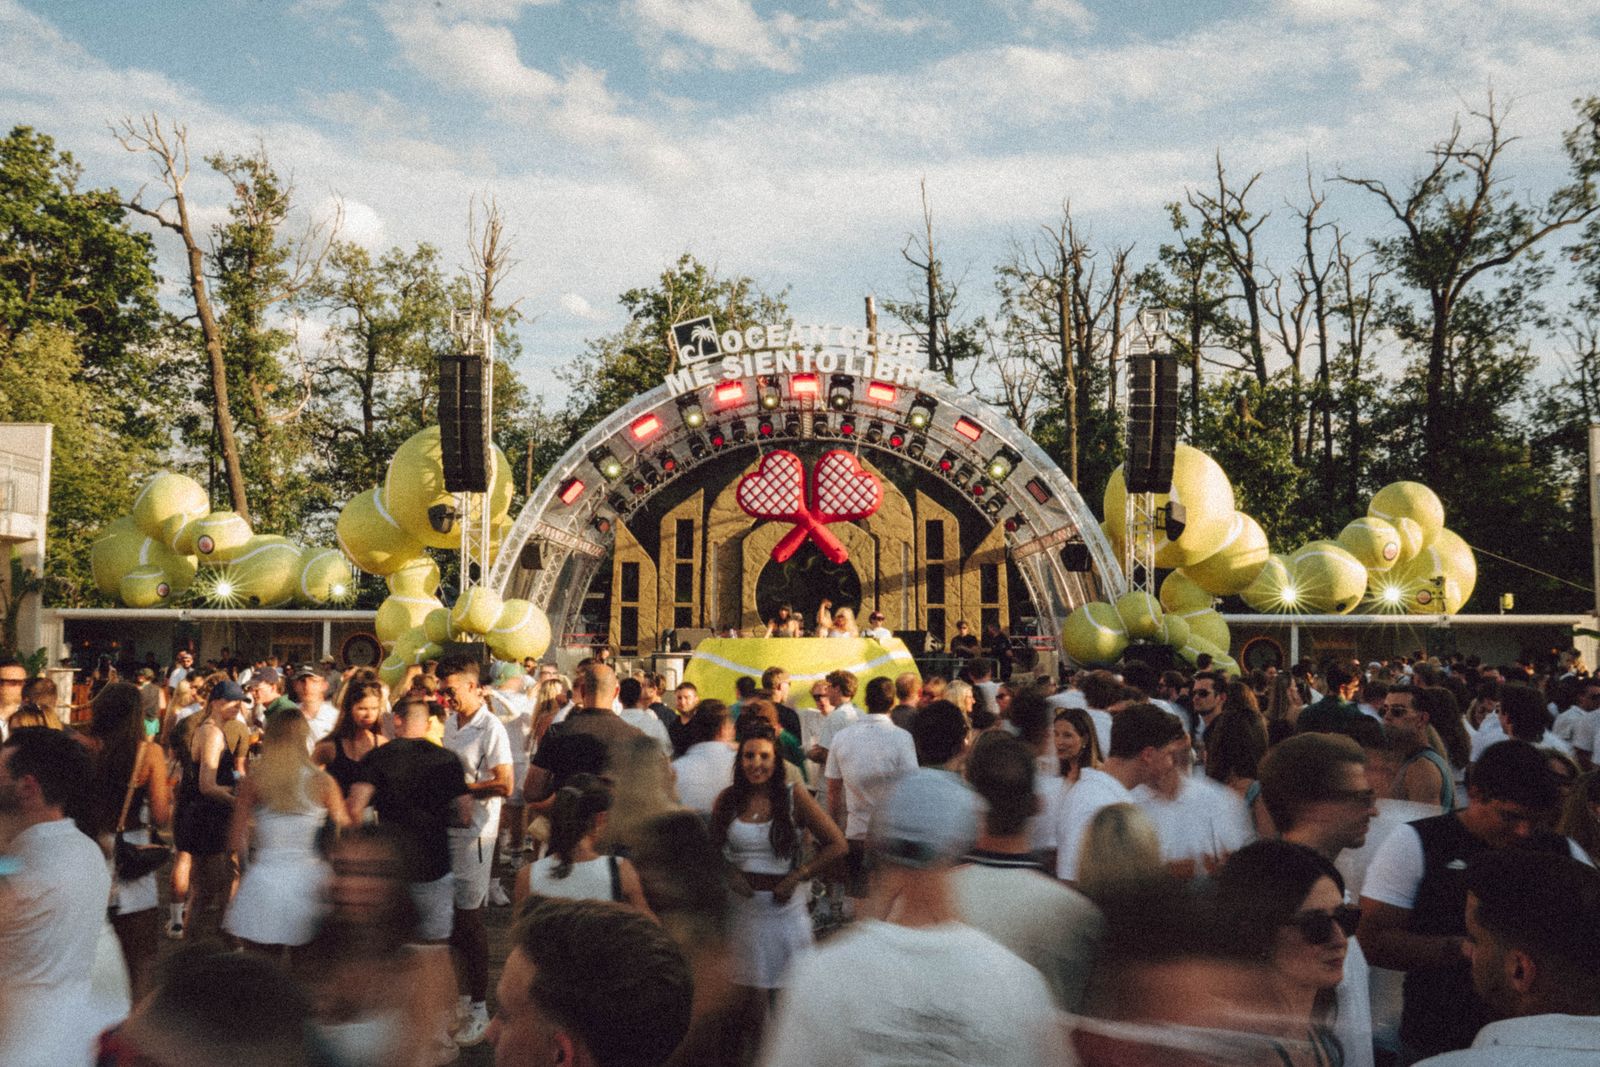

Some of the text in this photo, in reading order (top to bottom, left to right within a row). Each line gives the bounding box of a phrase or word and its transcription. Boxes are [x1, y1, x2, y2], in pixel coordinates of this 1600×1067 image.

[721, 322, 919, 356] OCEAN CLUB
[664, 362, 715, 397] ME
[721, 348, 838, 379] SIENTO
